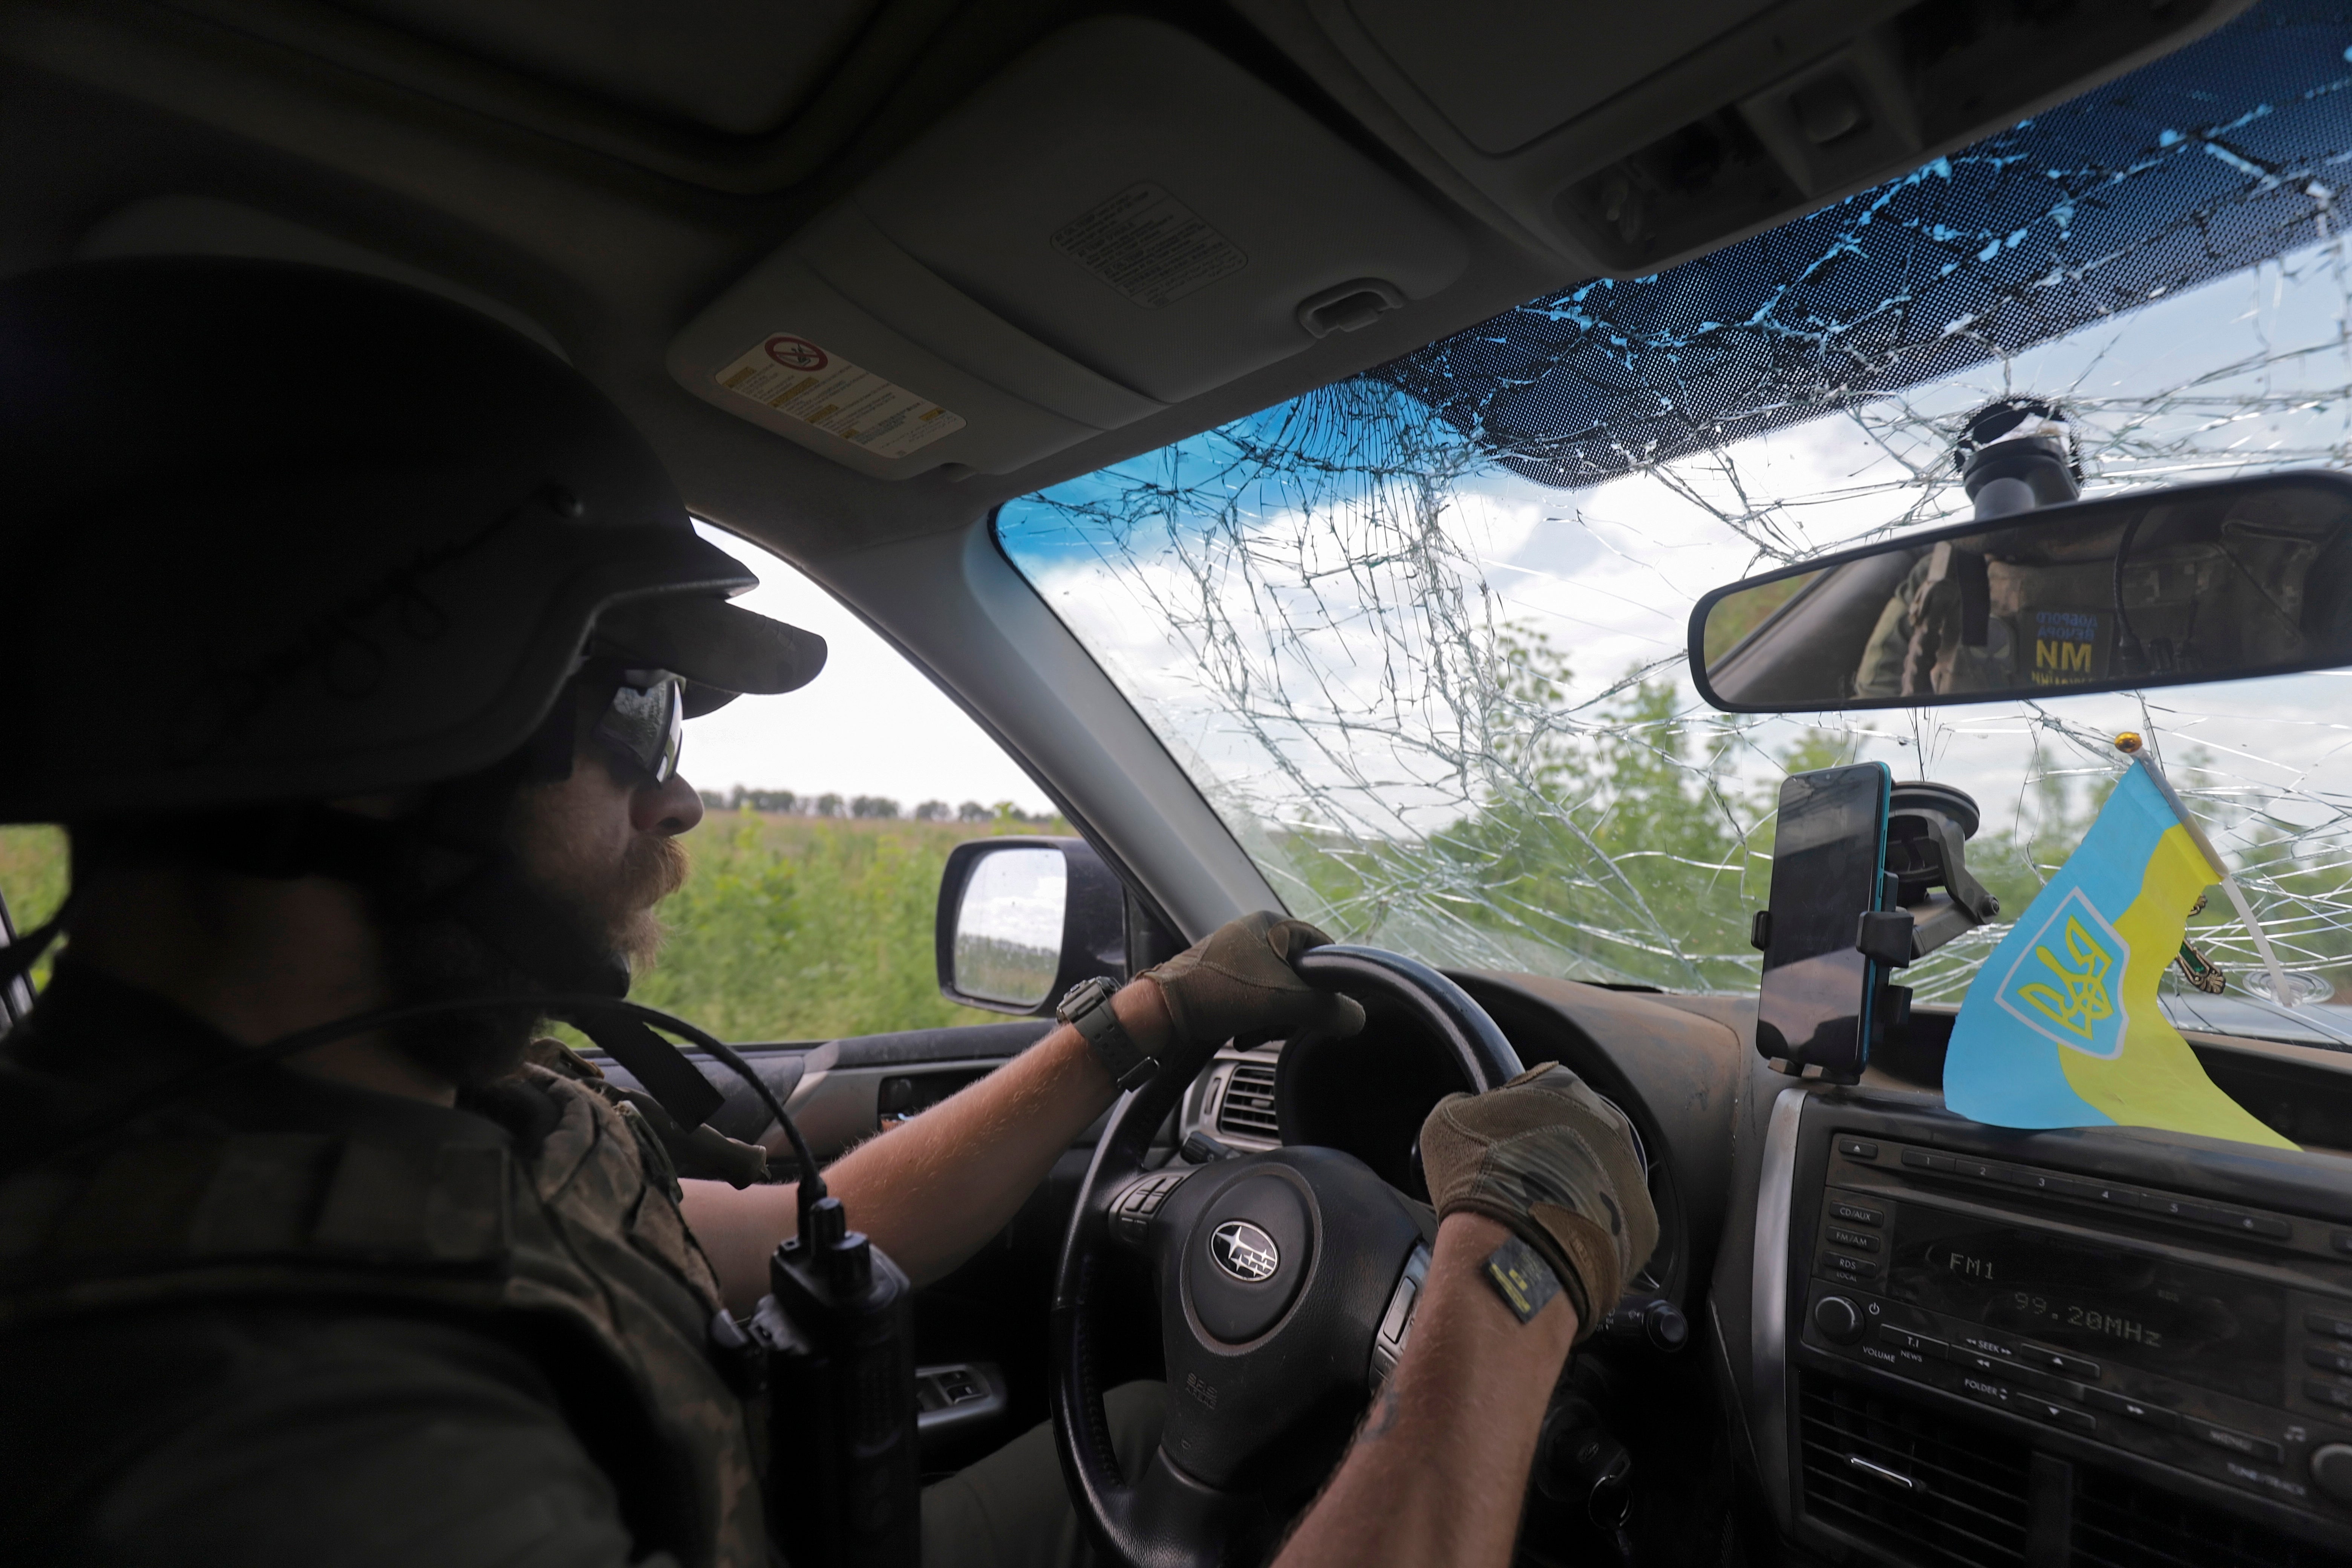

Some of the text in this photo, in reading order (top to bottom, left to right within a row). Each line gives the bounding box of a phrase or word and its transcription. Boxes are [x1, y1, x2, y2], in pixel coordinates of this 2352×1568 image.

[1926, 1156, 1930, 1165] 1
[1980, 1167, 1986, 1176] 2
[2038, 1178, 2045, 1187] 3
[2101, 1190, 2109, 1199] 4
[1839, 1207, 1871, 1221] CD/AUX
[2170, 1203, 2178, 1213] 5
[1836, 1231, 1867, 1246] FM/AM
[1839, 1258, 1856, 1270] RDS
[1950, 1252, 1994, 1280] FM1
[1836, 1271, 1857, 1282] LOCAL
[1977, 1339, 2000, 1354] SEEK
[1862, 1345, 1896, 1364] VOLUME
[1900, 1349, 1922, 1363] NEWS
[1964, 1377, 1997, 1396] FOLDER
